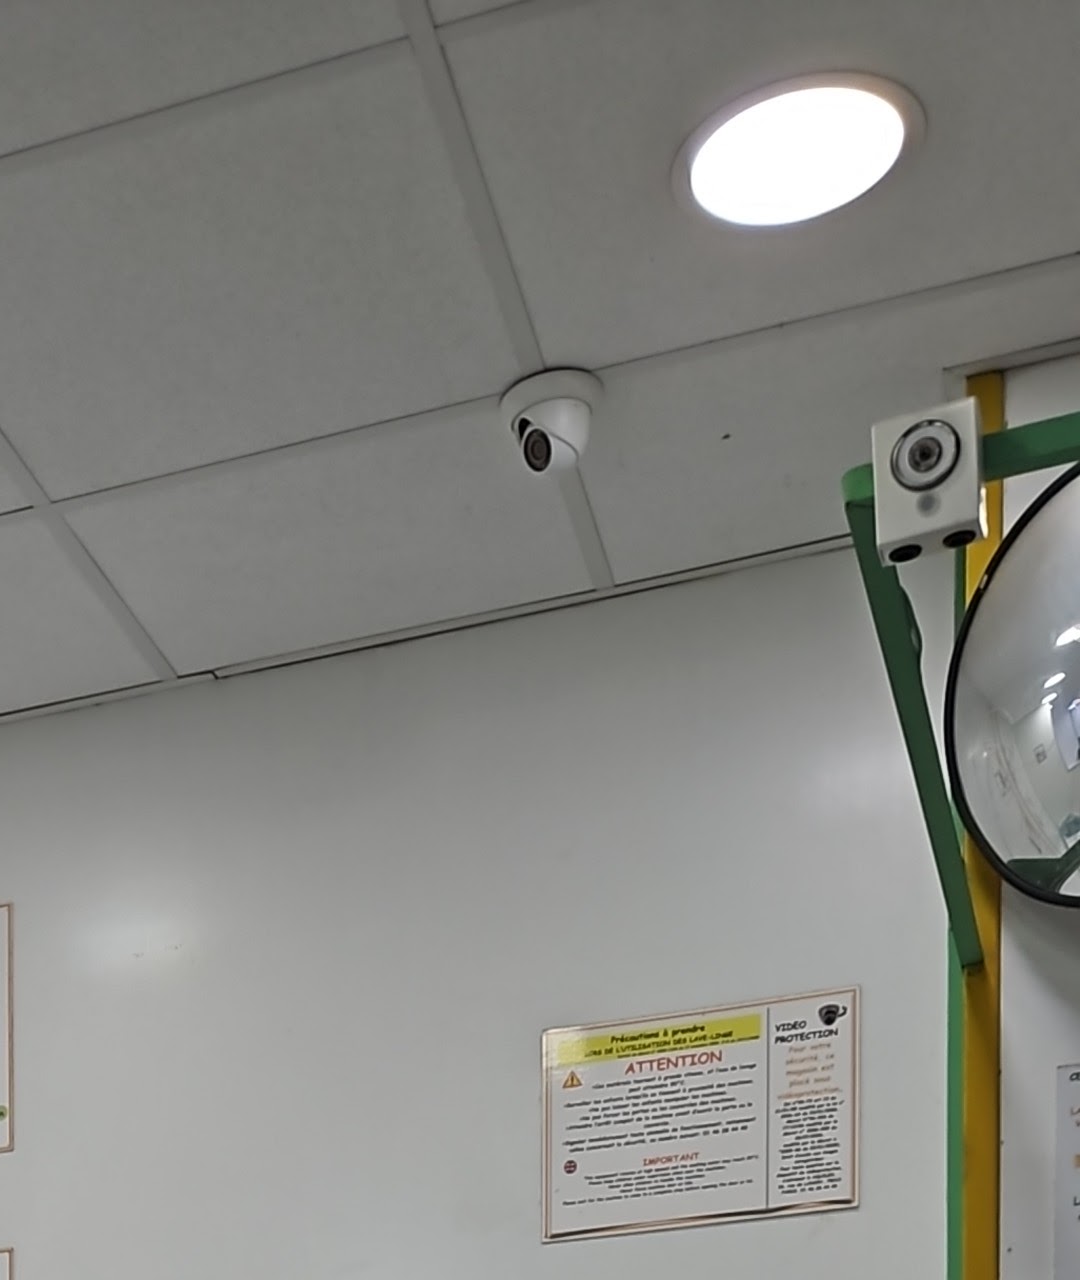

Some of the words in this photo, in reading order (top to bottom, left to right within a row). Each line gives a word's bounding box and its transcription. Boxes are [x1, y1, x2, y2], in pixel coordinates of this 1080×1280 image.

[775, 1020, 807, 1032] VIDEO
[775, 1028, 838, 1044] PROTECTION
[625, 1051, 722, 1075] ATTENTION
[643, 1152, 700, 1167] IMPORTANT
